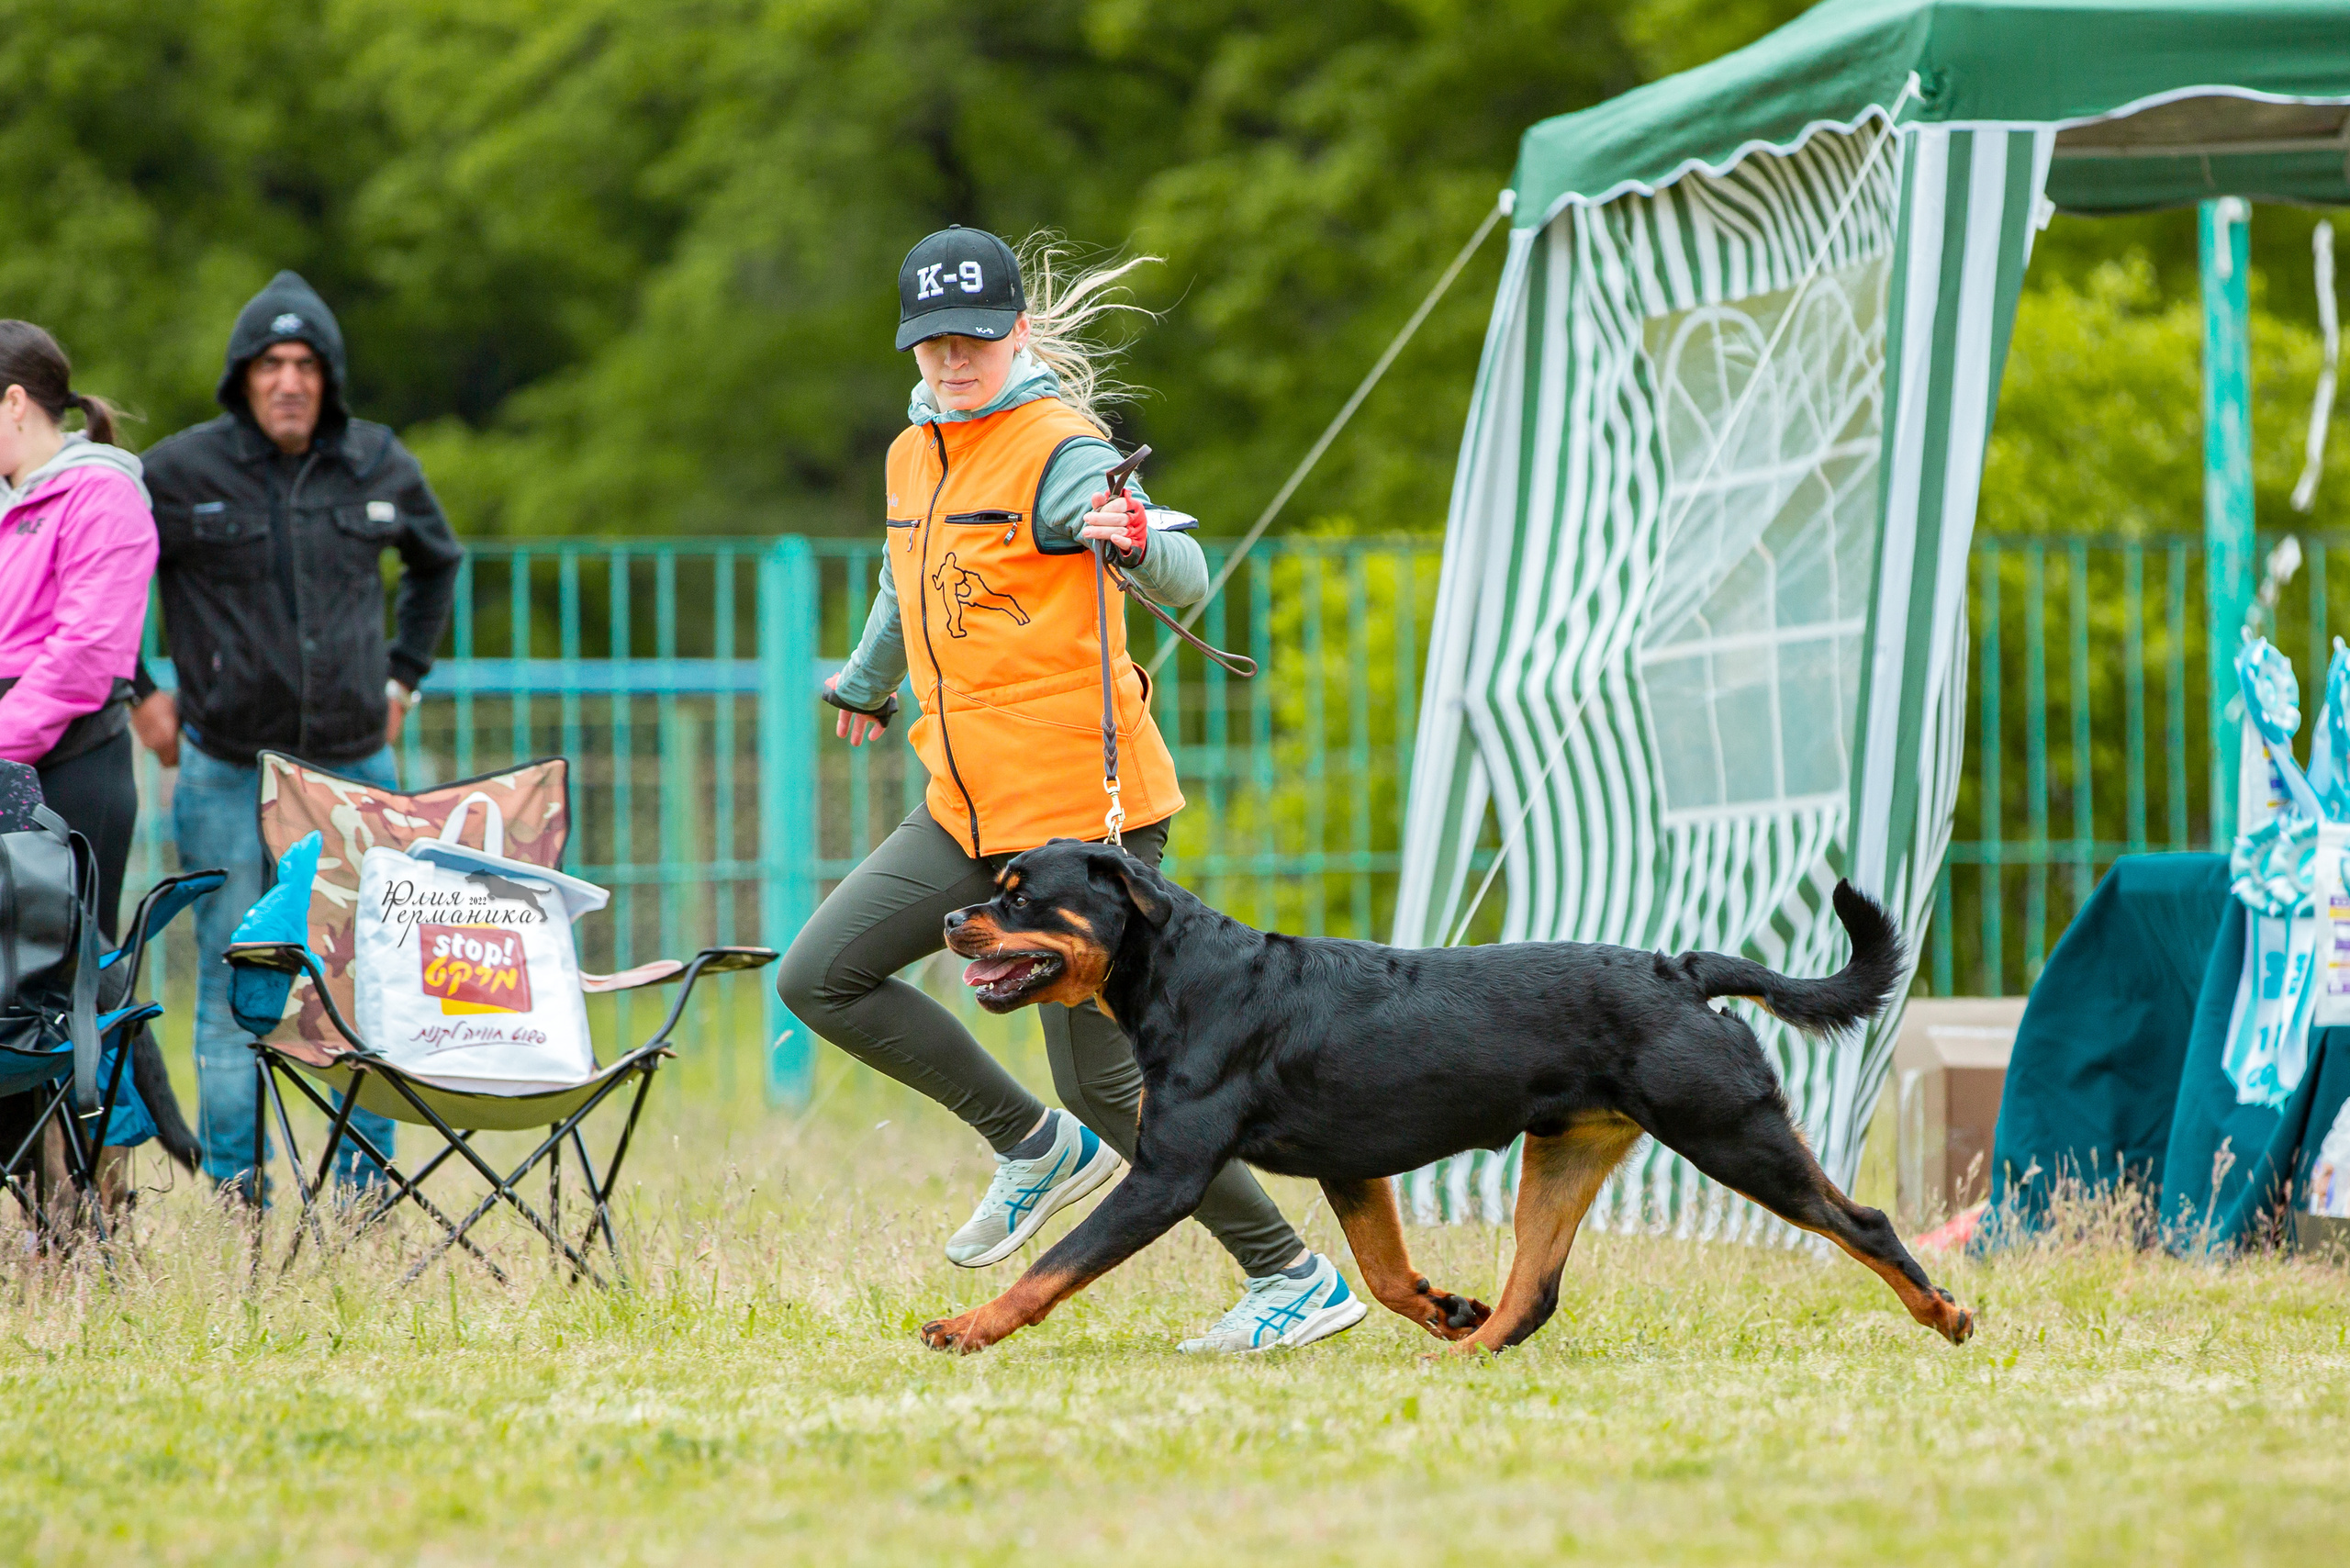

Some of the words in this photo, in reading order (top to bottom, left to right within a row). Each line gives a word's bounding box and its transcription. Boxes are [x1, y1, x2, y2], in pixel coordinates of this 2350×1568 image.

[917, 261, 983, 301] K-9
[432, 933, 515, 968] stop!
[424, 955, 519, 996] מרקט
[408, 1020, 467, 1047] לקנות
[463, 1026, 503, 1040] חוויה
[511, 1026, 547, 1044] פשוט
